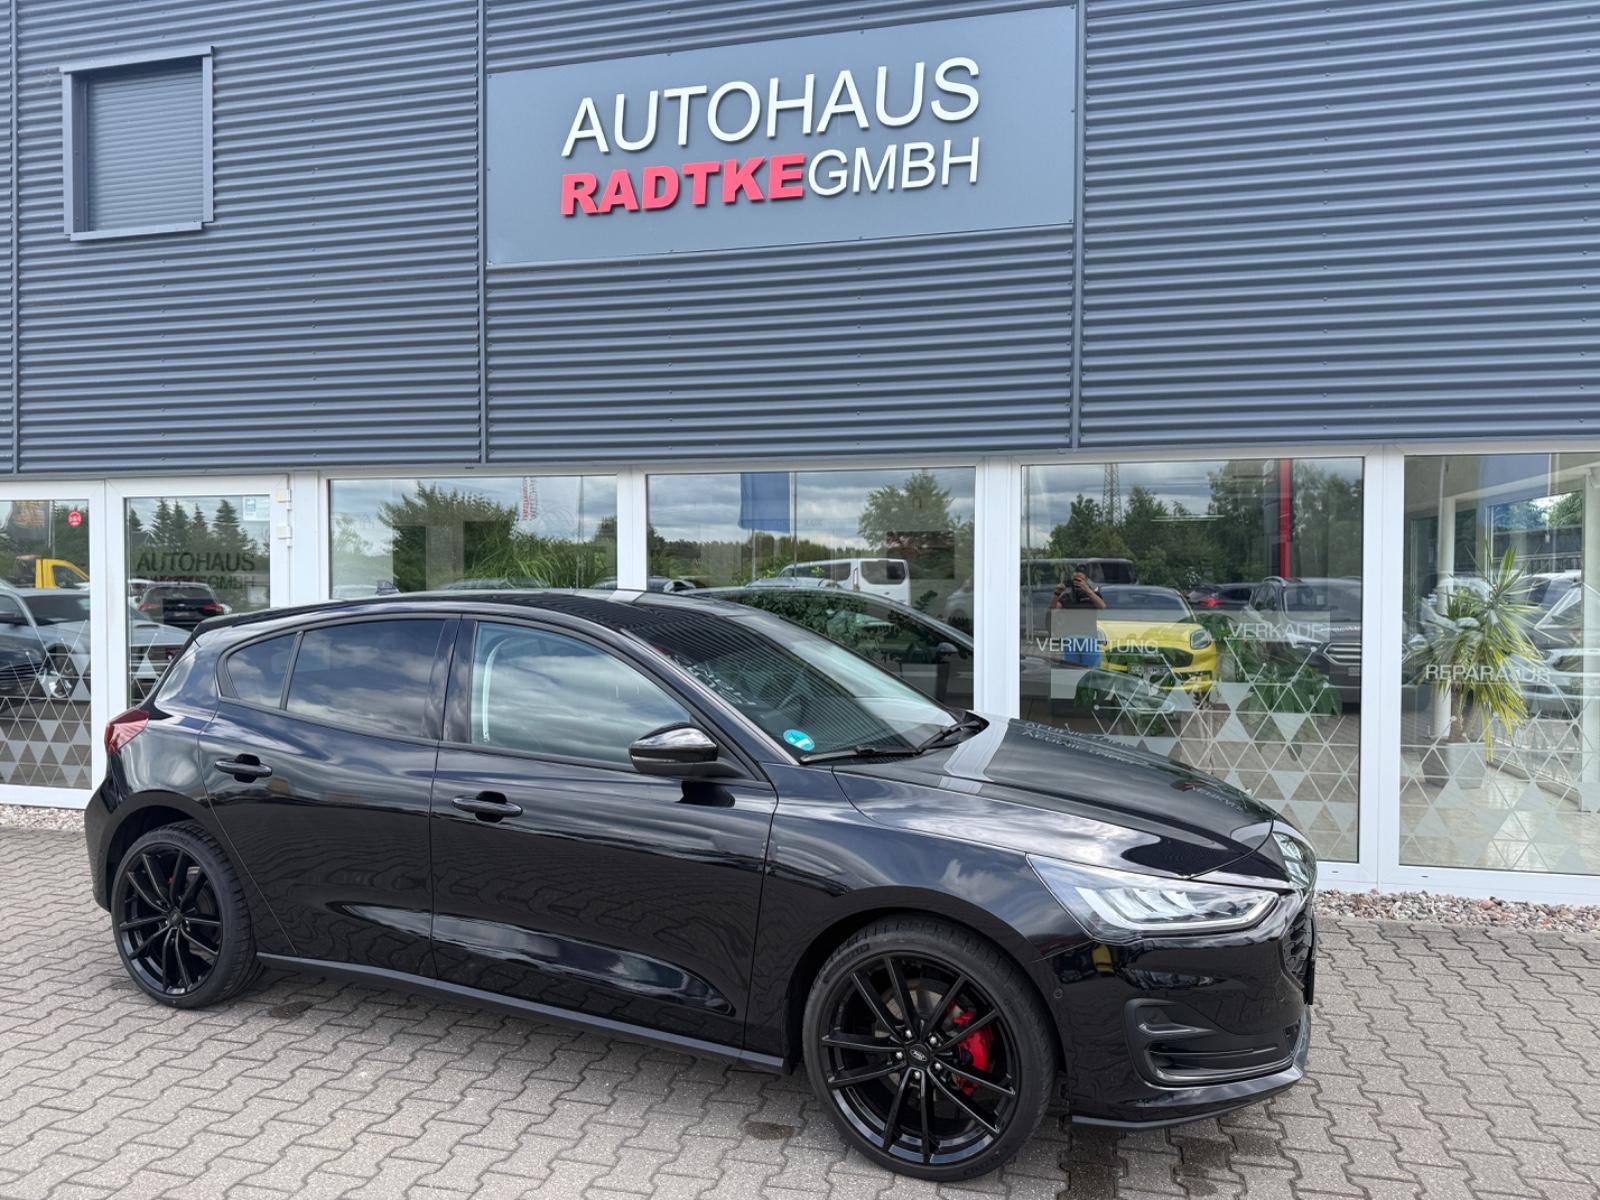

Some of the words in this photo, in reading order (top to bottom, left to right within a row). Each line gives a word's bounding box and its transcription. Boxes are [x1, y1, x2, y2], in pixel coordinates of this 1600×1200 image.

[561, 57, 979, 157] AUTOHAUS
[136, 552, 255, 572] AUTOHAUS
[1227, 622, 1323, 639] VERKAUF
[1036, 637, 1159, 654] VERMIETUNG
[1425, 664, 1551, 682] REPARAUR
